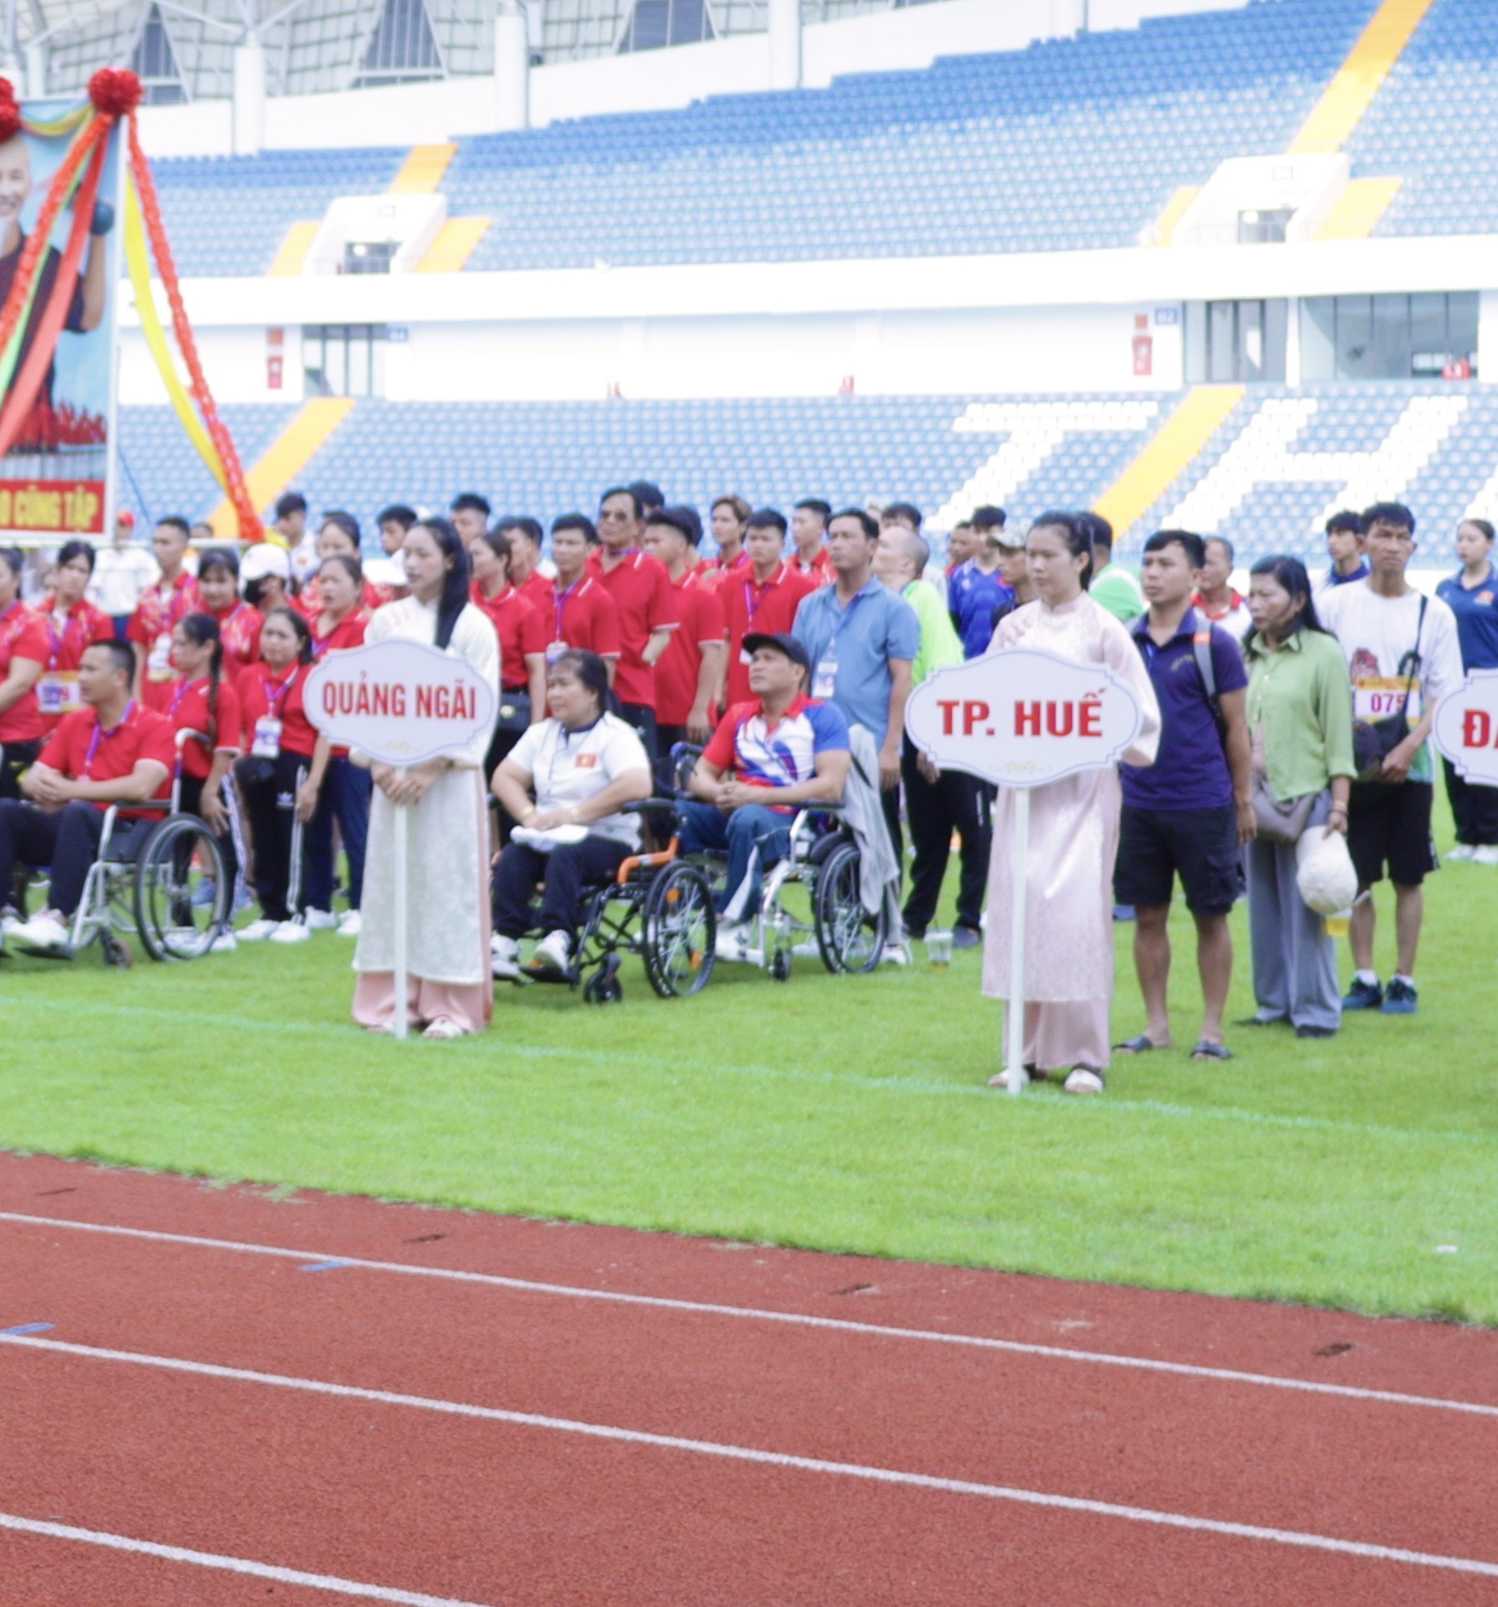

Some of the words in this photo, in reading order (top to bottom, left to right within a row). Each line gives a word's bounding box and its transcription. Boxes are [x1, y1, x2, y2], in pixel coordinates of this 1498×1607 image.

[323, 670, 406, 718] QUẢNG
[415, 678, 476, 720] NGÃI
[936, 700, 996, 736] TP.
[1013, 687, 1108, 738] HUẾ
